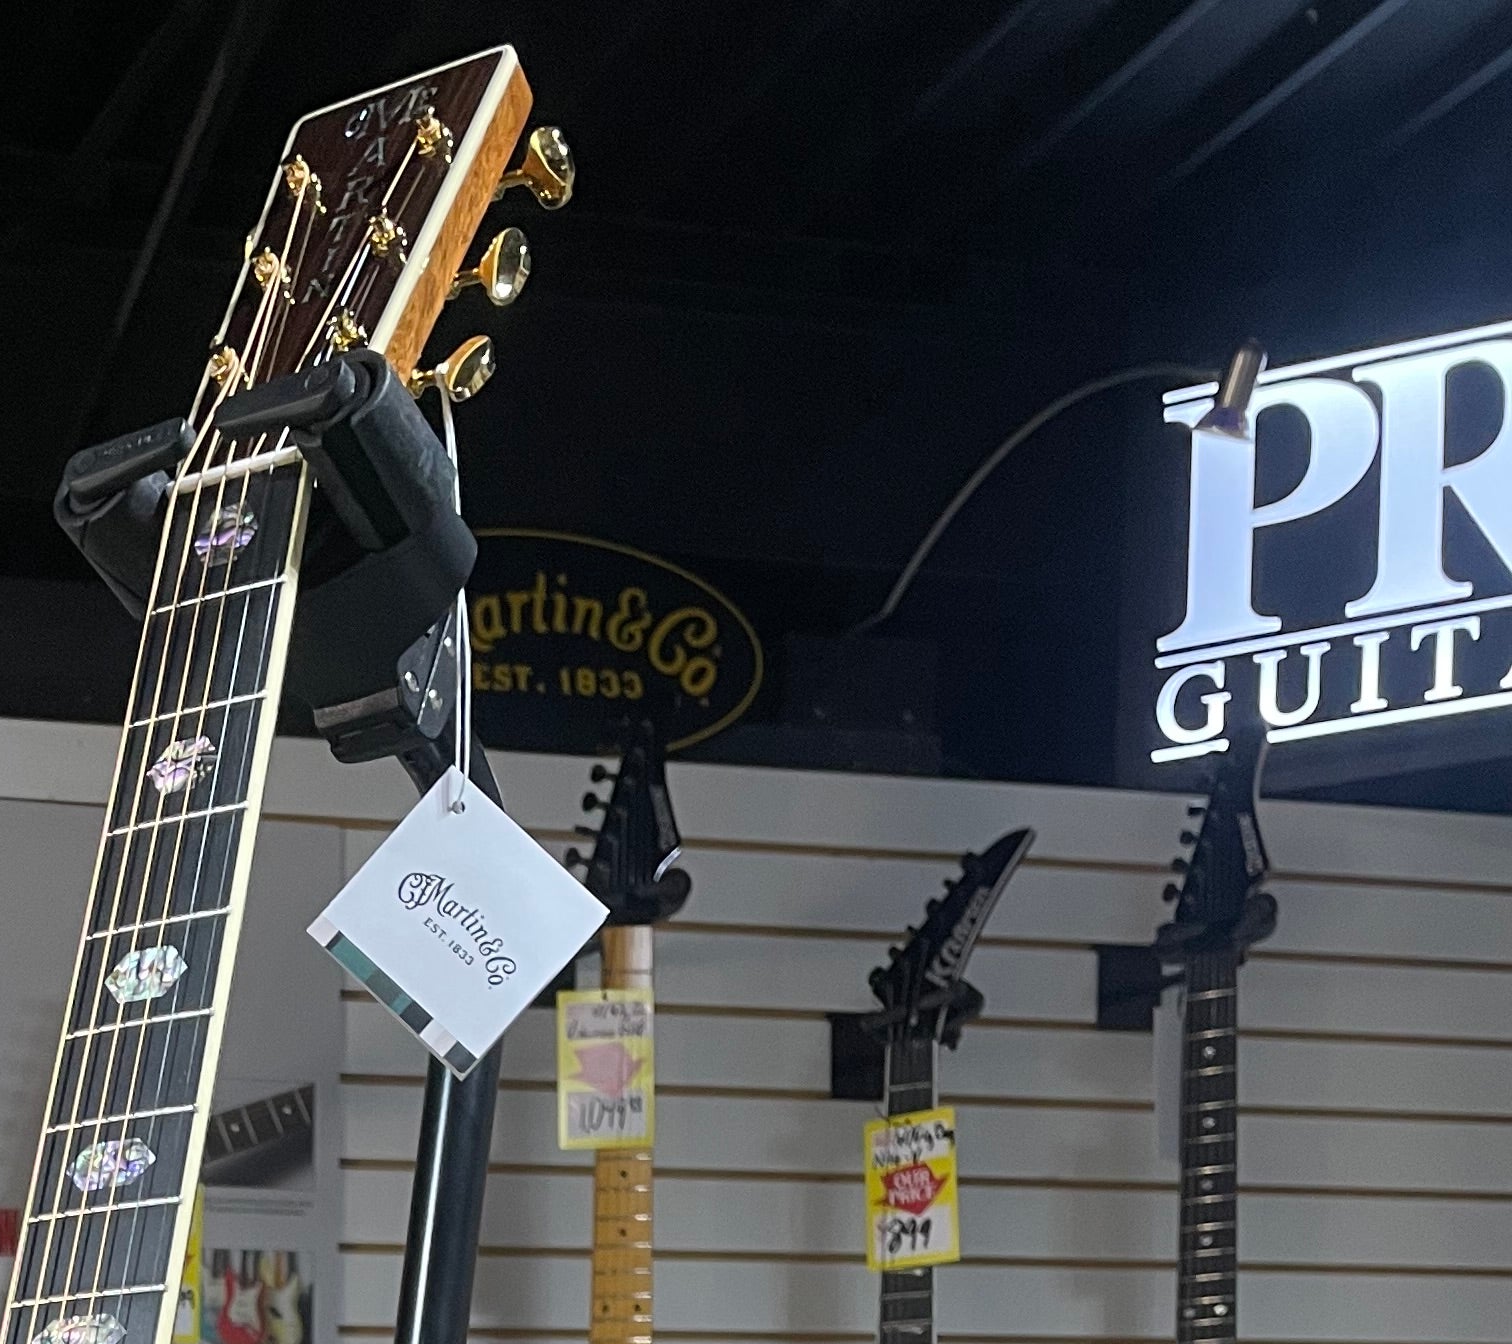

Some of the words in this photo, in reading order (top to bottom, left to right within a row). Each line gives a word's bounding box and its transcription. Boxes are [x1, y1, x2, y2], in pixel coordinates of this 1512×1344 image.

[1157, 338, 1512, 653] PR
[560, 666, 644, 700] 1833
[1156, 616, 1512, 745] GUIT
[447, 939, 475, 967] 1833
[893, 1169, 931, 1189] OUR
[889, 1185, 933, 1207] PRICE
